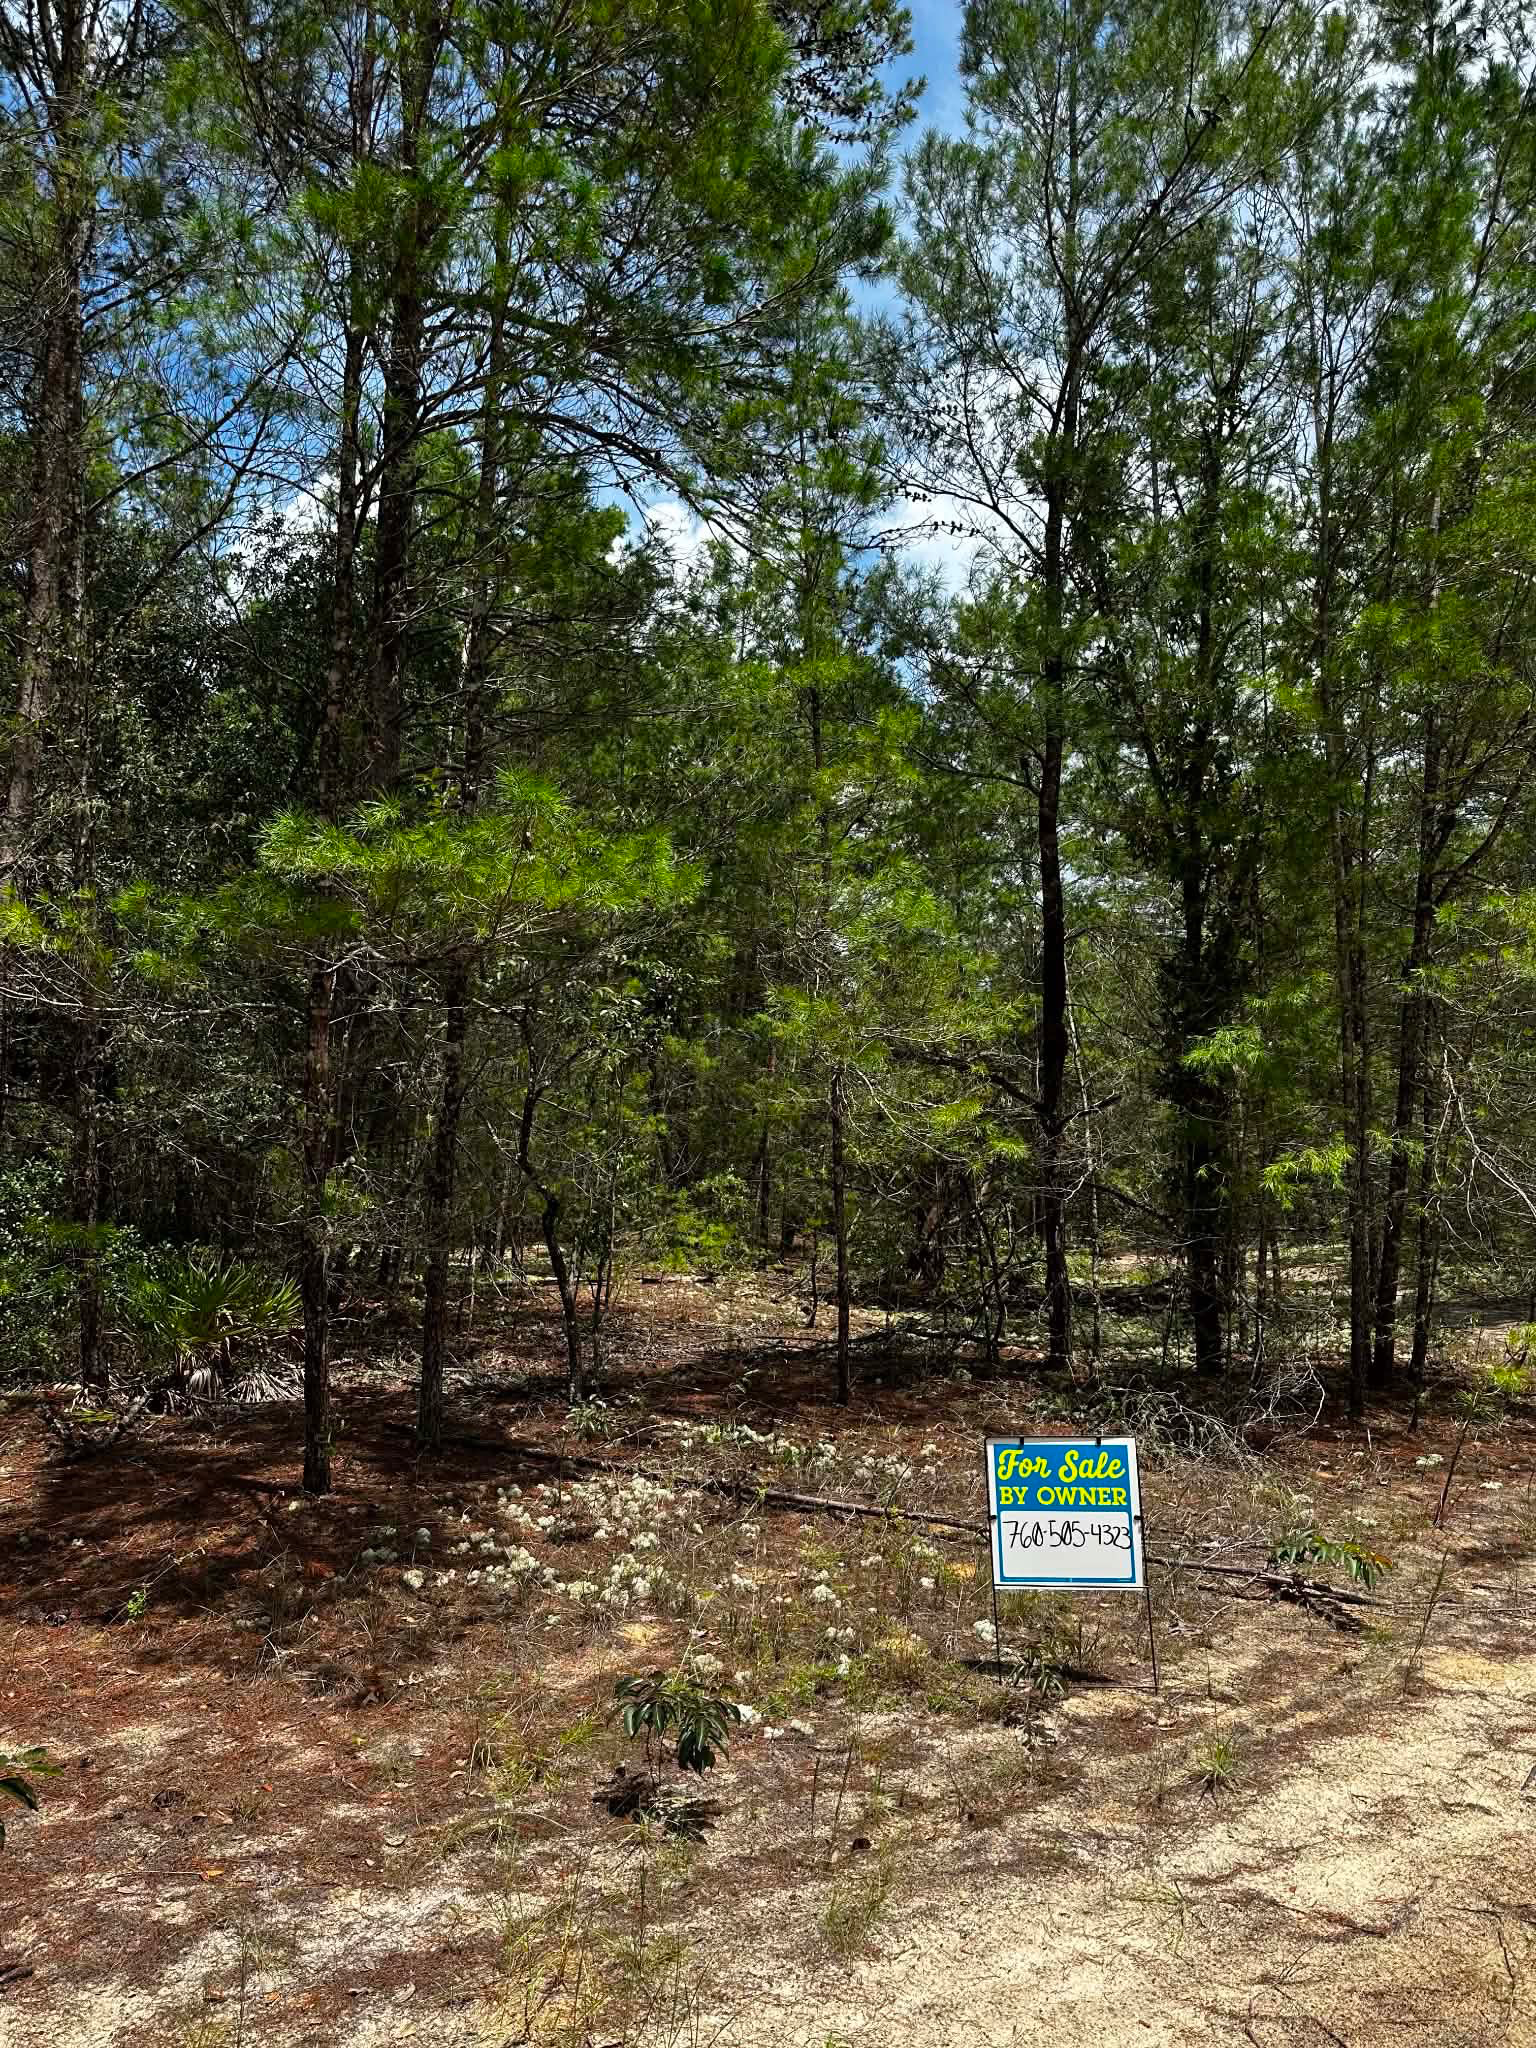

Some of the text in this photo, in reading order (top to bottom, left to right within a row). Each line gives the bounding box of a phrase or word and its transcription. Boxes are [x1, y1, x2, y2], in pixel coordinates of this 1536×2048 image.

[998, 1449, 1126, 1483] For Sale
[1000, 1486, 1127, 1505] BY OWNER
[1002, 1520, 1132, 1549] 760-505-4323
